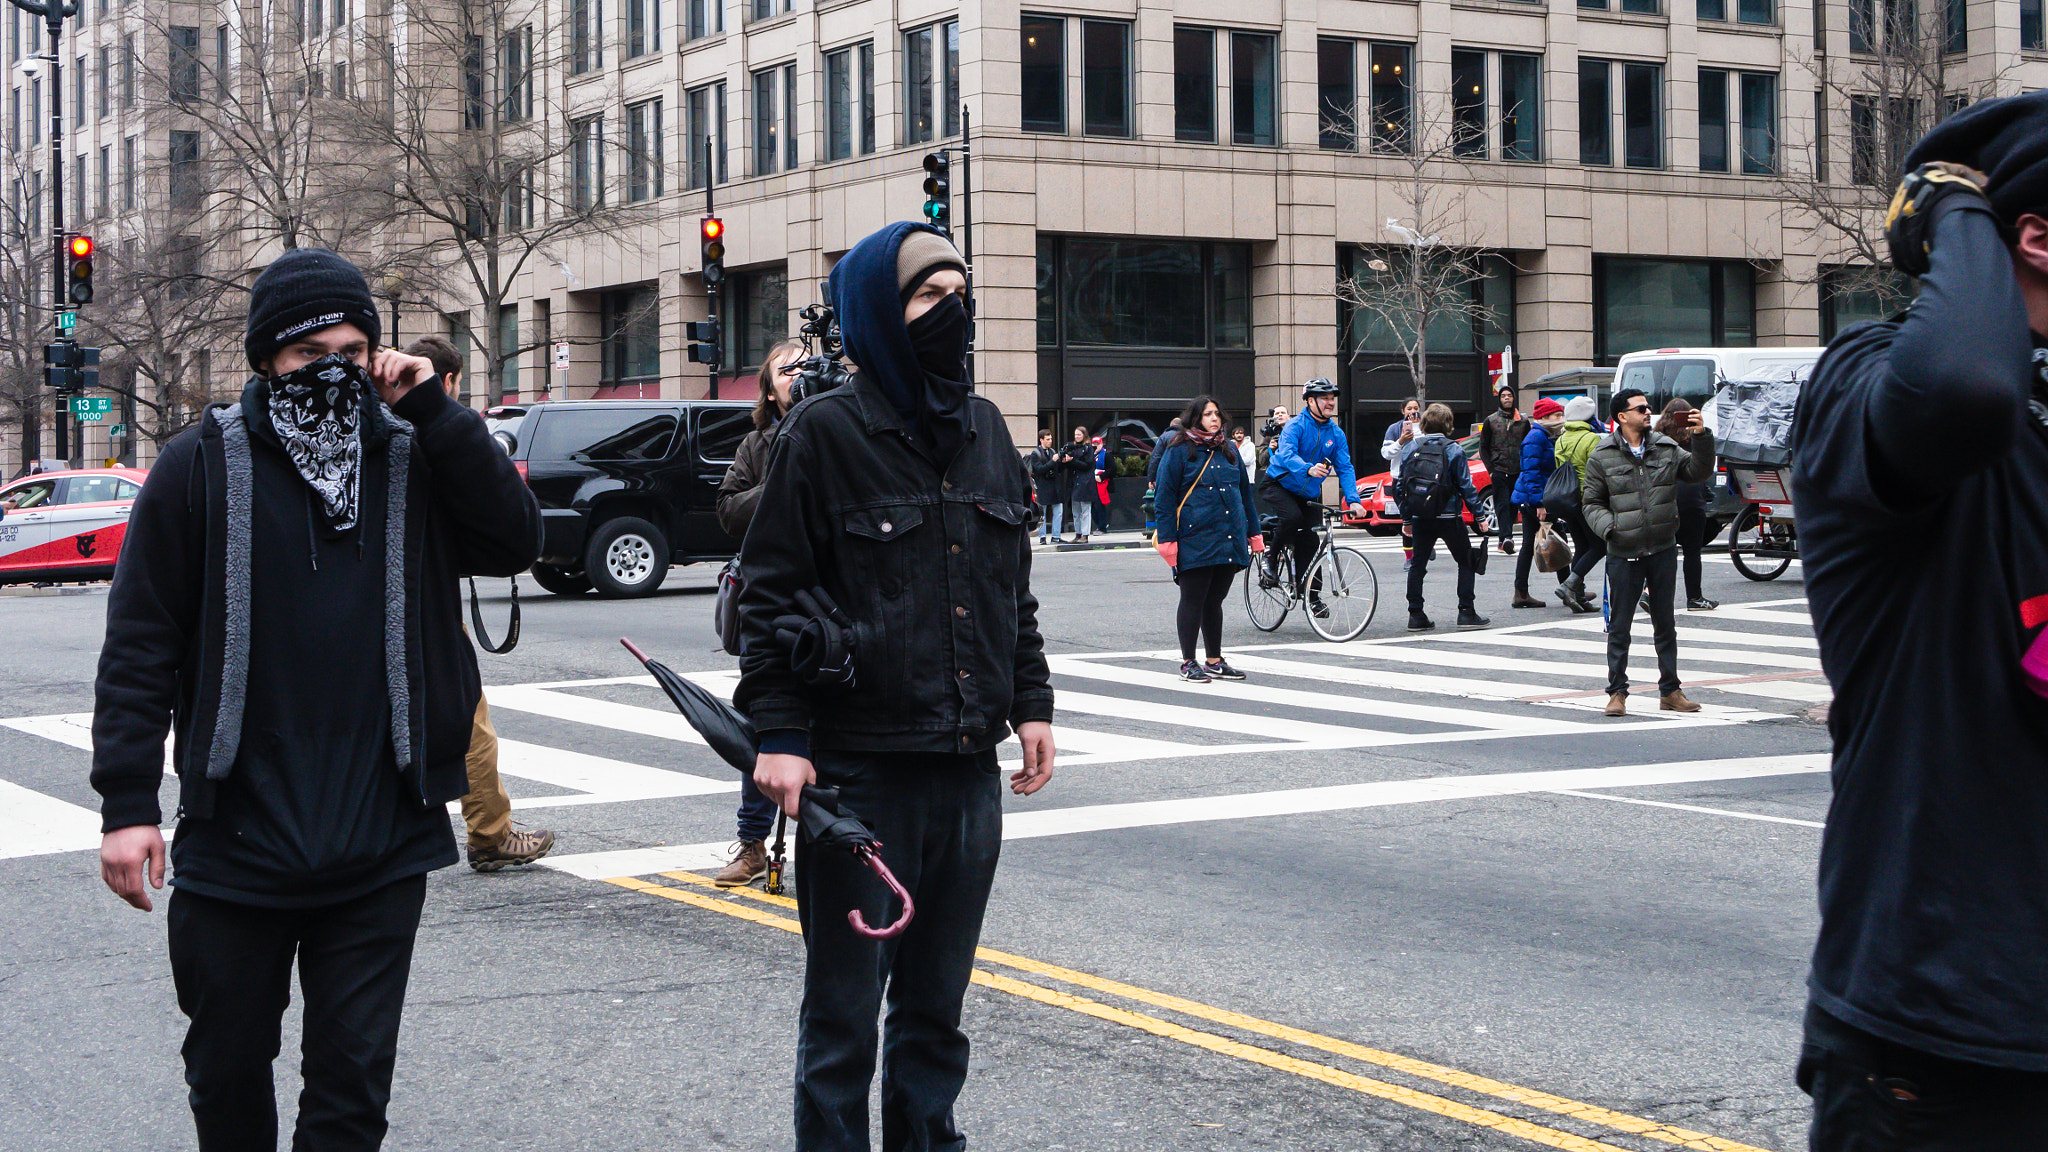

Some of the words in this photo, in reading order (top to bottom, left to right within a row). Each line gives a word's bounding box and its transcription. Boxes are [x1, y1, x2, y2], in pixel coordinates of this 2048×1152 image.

[64, 315, 70, 326] K
[285, 317, 317, 334] BALLAST
[319, 312, 345, 322] POINT
[76, 399, 90, 411] 13
[78, 412, 102, 420] 1000
